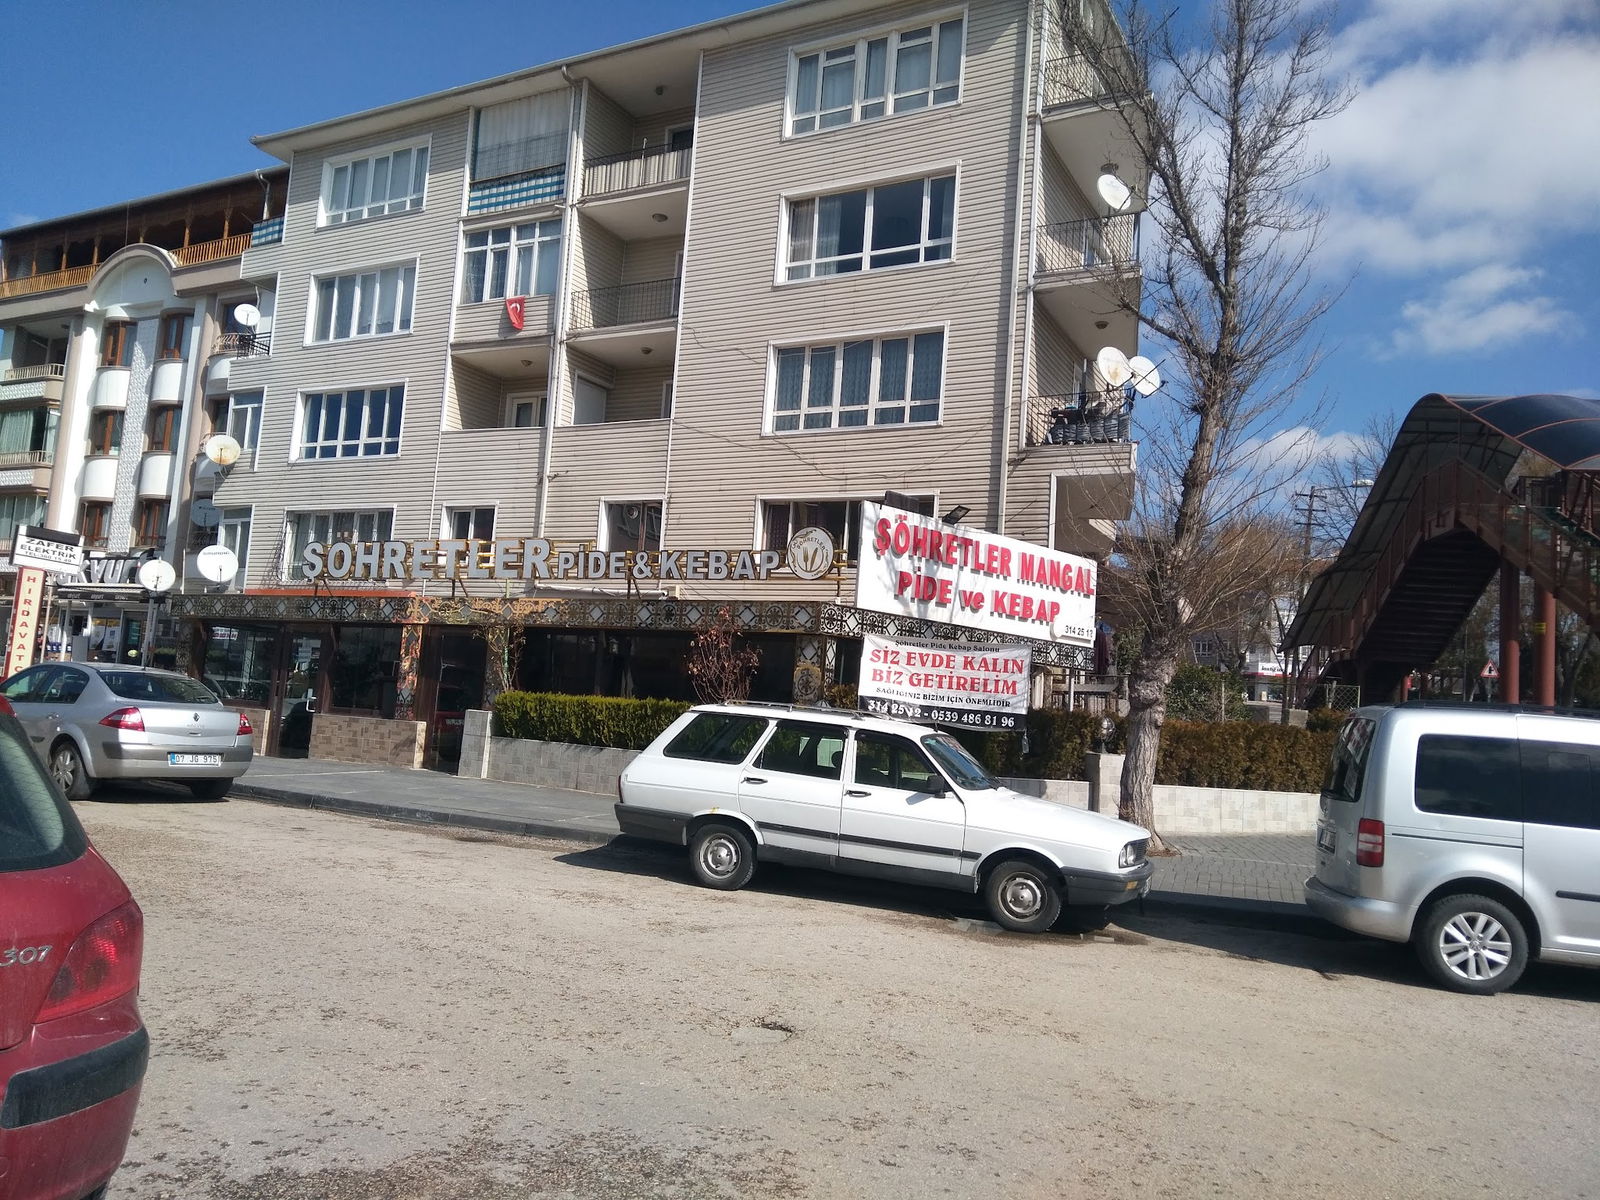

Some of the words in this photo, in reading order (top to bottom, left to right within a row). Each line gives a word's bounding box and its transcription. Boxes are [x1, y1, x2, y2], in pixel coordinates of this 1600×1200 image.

[26, 537, 74, 552] ZAFER
[874, 514, 1012, 578] ŞÖHRETLER
[1020, 552, 1095, 596] MANGAL
[557, 543, 627, 580] PİDE
[631, 550, 654, 580] &
[659, 550, 781, 580] KEBAP
[895, 566, 953, 605] PİDE
[960, 590, 985, 610] ve
[993, 590, 1061, 623] KEBAP
[1065, 625, 1076, 635] 314
[1077, 627, 1085, 637] 25
[948, 643, 972, 652] Kebap
[869, 646, 900, 665] SİZ
[905, 651, 956, 669] EVDE
[962, 655, 1025, 675] KALIN
[871, 666, 904, 686] BİZ
[908, 670, 1018, 696] GETİRELİM
[922, 692, 945, 702] BİZİM
[946, 694, 964, 704] İÇİN
[965, 697, 1011, 708] ÖNEMLİDİR
[868, 699, 889, 713] 314
[891, 703, 905, 715] 25
[931, 710, 959, 722] 0539
[961, 712, 982, 724] 486
[984, 714, 997, 726] 81
[1001, 716, 1015, 727] 96
[176, 754, 185, 763] 07
[203, 755, 218, 763] 975
[0, 944, 53, 967] 307
